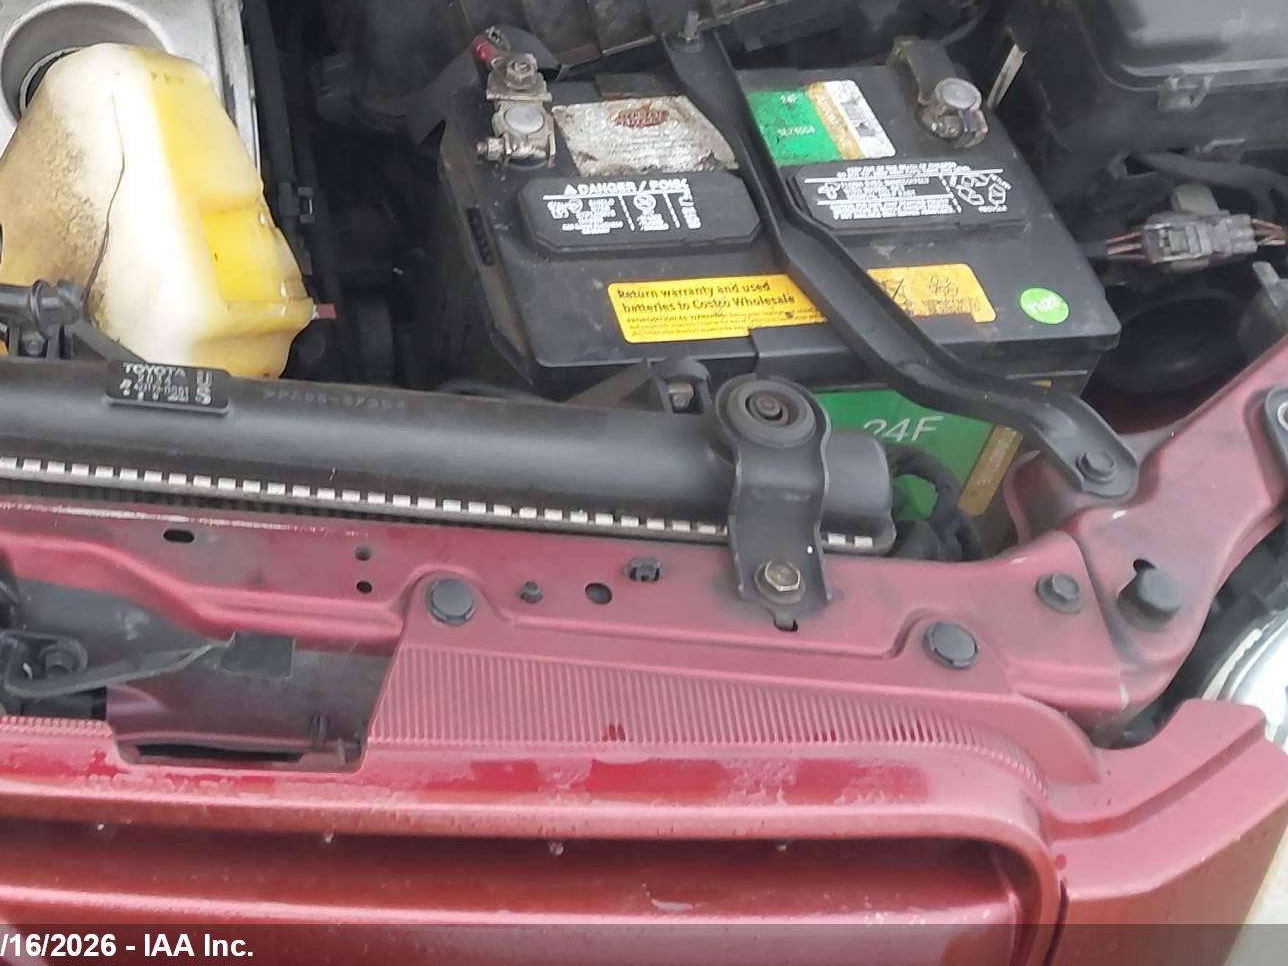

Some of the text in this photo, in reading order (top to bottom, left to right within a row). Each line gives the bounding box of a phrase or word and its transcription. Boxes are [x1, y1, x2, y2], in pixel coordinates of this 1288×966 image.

[577, 181, 637, 196] DANGER
[617, 281, 771, 300] Return warranty and used
[623, 294, 795, 313] batteries to Costco Wholesale
[123, 362, 187, 378] TOYOTA
